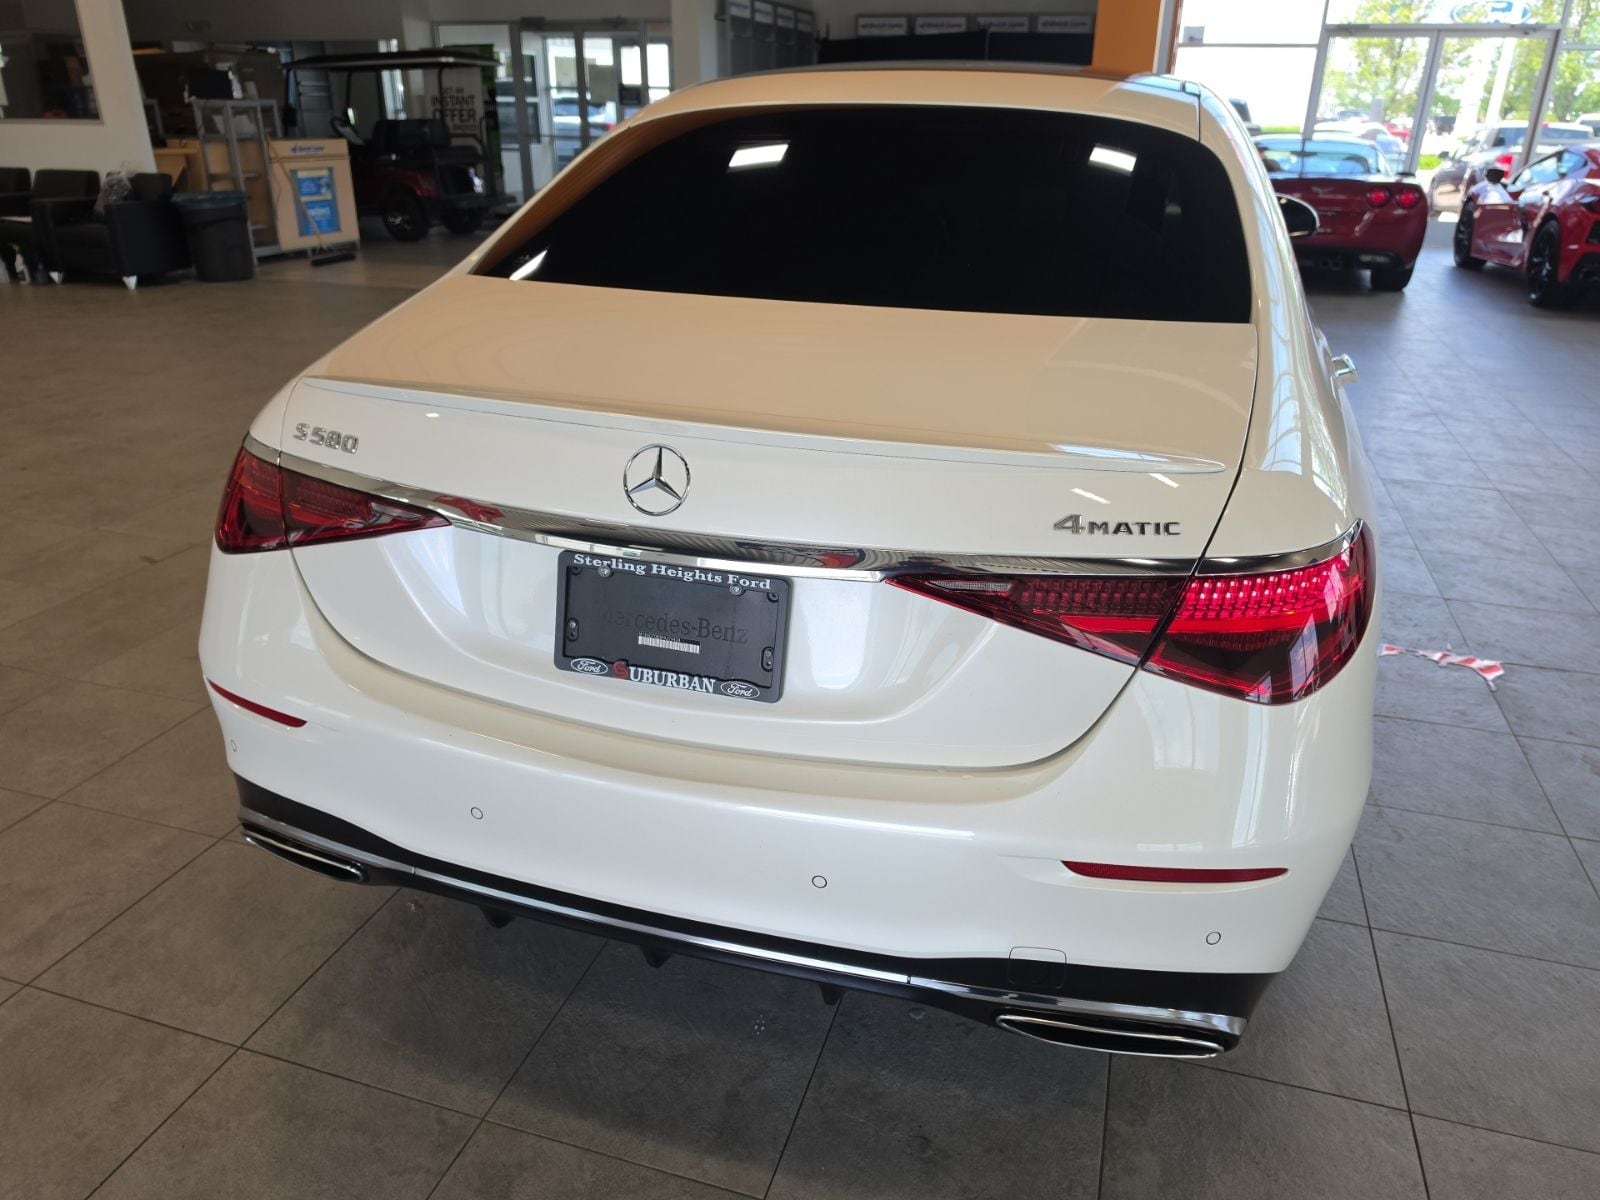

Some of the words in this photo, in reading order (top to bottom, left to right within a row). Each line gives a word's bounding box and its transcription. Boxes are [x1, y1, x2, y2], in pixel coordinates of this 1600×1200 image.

[292, 422, 310, 441] S
[308, 426, 360, 454] 580
[1053, 514, 1181, 535] 4MATIC
[573, 553, 647, 575] Sterling
[651, 563, 722, 582] Heights
[727, 574, 771, 590] Ford
[576, 659, 602, 673] Ford
[613, 660, 716, 693] SUBURBAN
[726, 682, 754, 697] Ford
